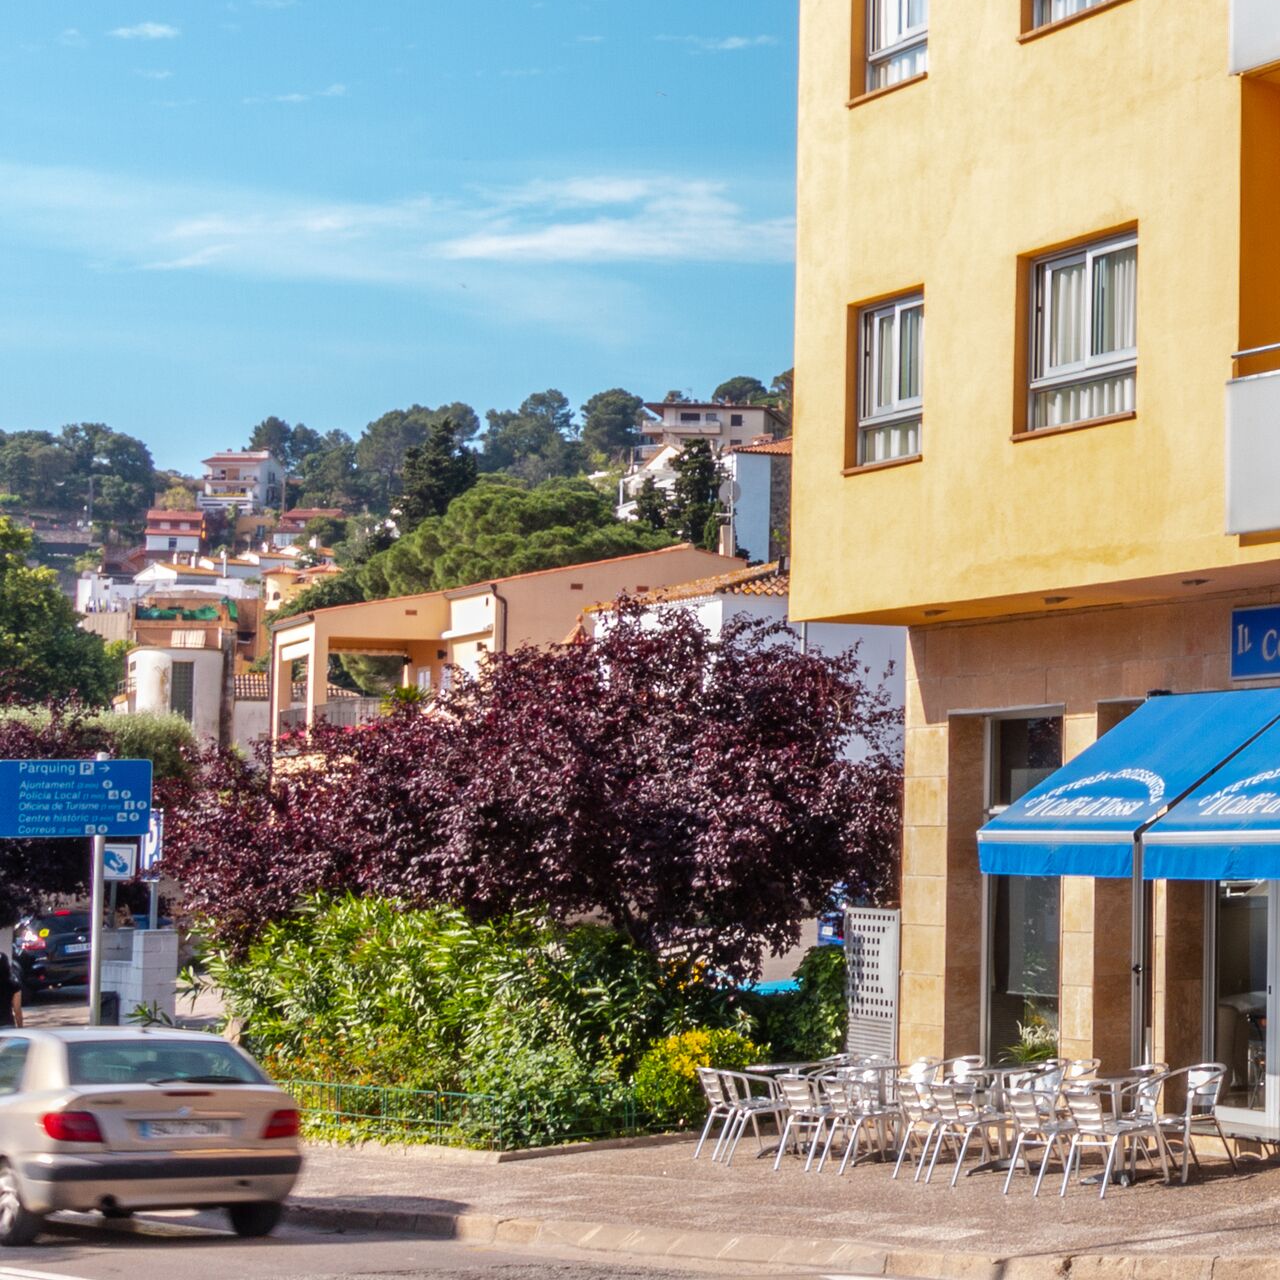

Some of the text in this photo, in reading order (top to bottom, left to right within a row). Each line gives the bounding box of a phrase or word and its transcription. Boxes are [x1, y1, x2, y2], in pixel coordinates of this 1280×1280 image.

[19, 780, 75, 790] Ajuntament
[54, 791, 81, 800] Local
[18, 802, 50, 811] Oficina
[52, 802, 63, 811] de
[65, 802, 99, 811] Turisme
[18, 814, 51, 823] Centre
[18, 825, 56, 834] Correus
